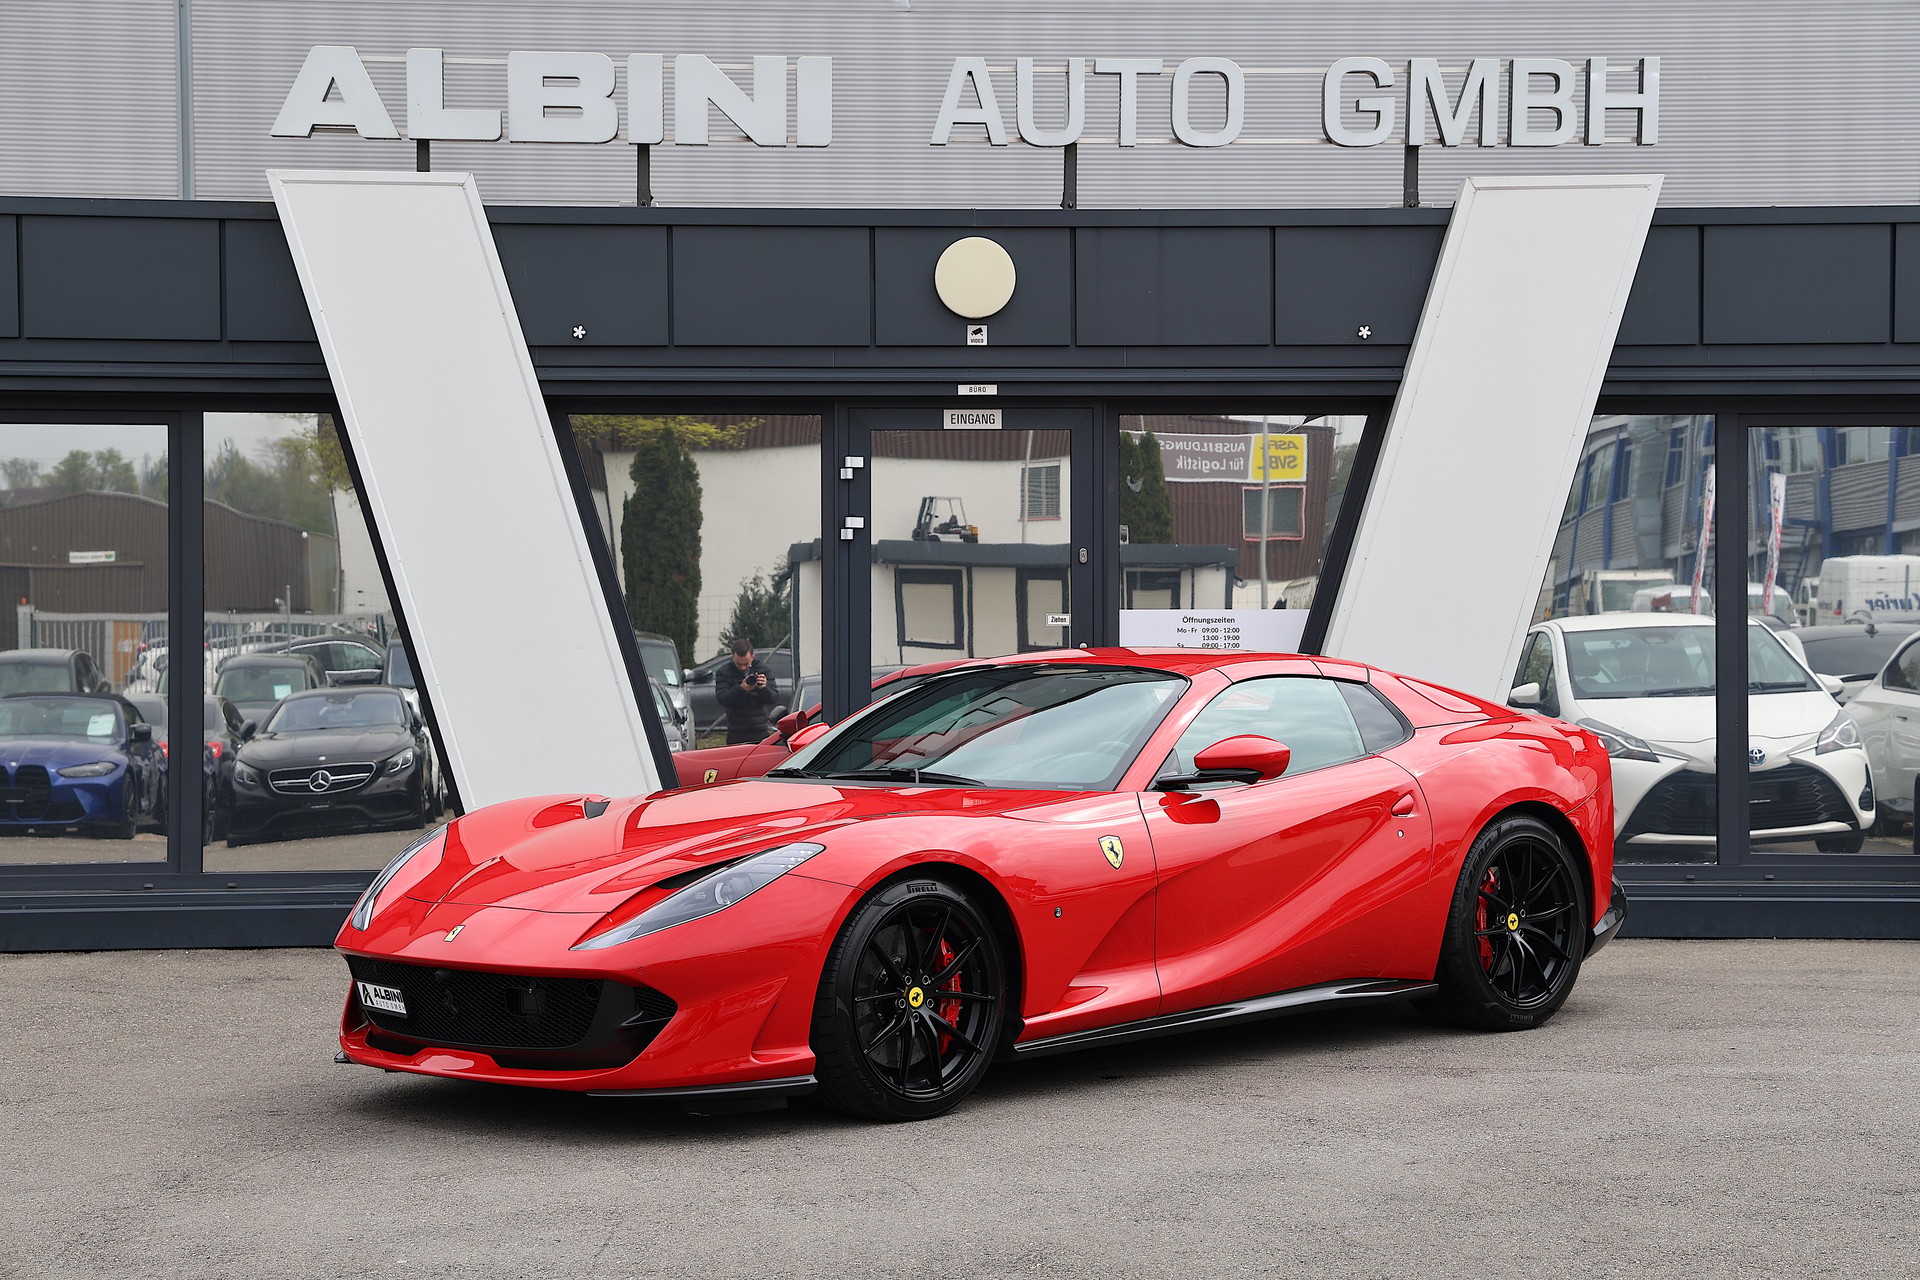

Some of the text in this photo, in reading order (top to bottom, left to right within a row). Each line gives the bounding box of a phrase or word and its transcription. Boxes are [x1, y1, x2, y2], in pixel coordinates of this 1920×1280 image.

[270, 45, 1660, 149] ALBINI AUTO GMBH
[969, 385, 987, 393] BÜRO
[950, 413, 996, 425] EINGANG
[1182, 615, 1236, 624] Öffnungszeiten
[906, 882, 938, 893] PIRELLI
[374, 987, 404, 1003] ALBINI
